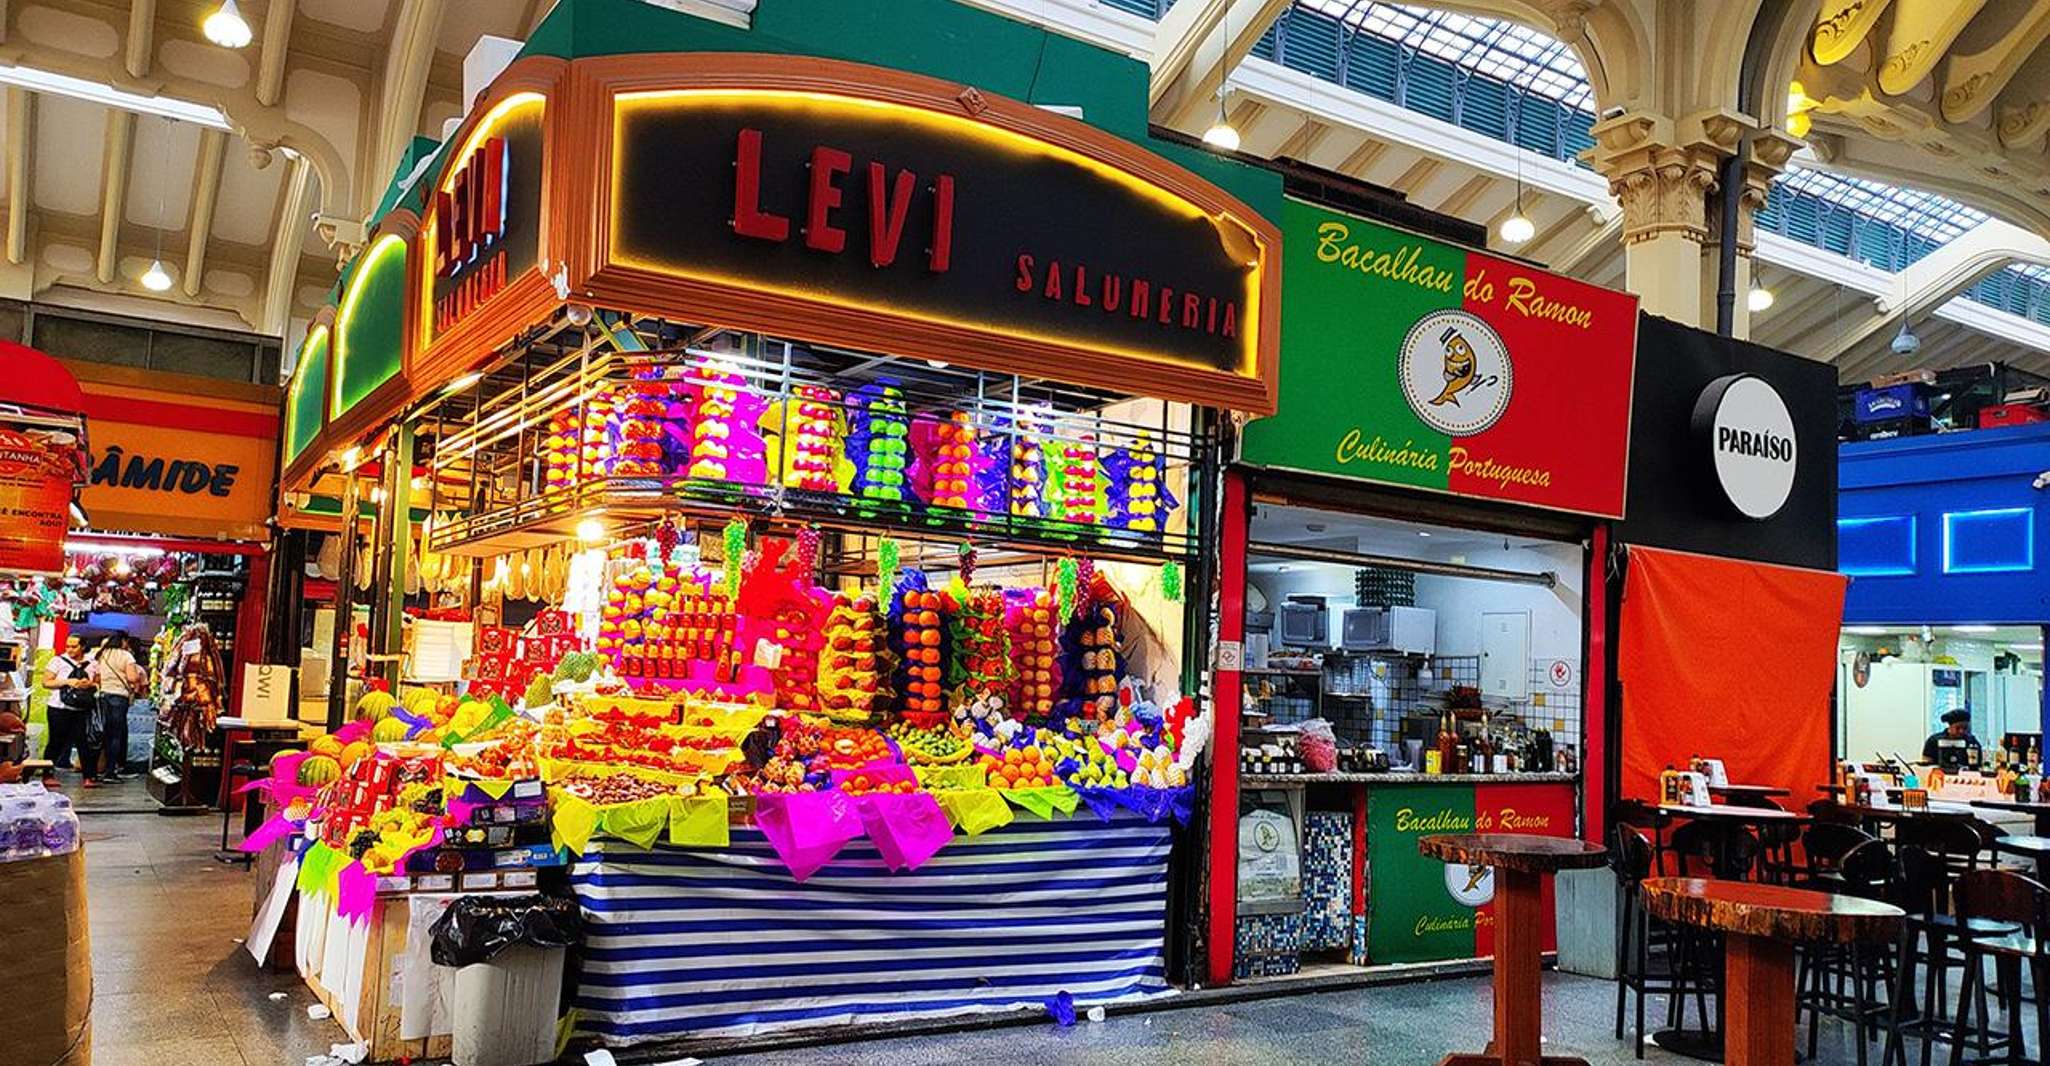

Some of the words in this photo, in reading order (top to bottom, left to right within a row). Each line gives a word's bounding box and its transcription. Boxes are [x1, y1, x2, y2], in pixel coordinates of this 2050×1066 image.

[734, 129, 954, 272] LEVI
[1016, 254, 1237, 338] SALUMERIA
[1316, 222, 1453, 293] Bacalhau
[1463, 270, 1495, 302] do
[1505, 277, 1592, 328] Ramon
[88, 445, 240, 497] ÂMIDE
[1335, 428, 1438, 470] Culinária
[1447, 447, 1551, 489] Portuguesa
[1719, 427, 1792, 462] PARAÍSO
[1396, 807, 1470, 832] Bacalhau
[1475, 810, 1493, 830] do
[1500, 807, 1550, 831] Ramon
[1475, 911, 1497, 929] Por
